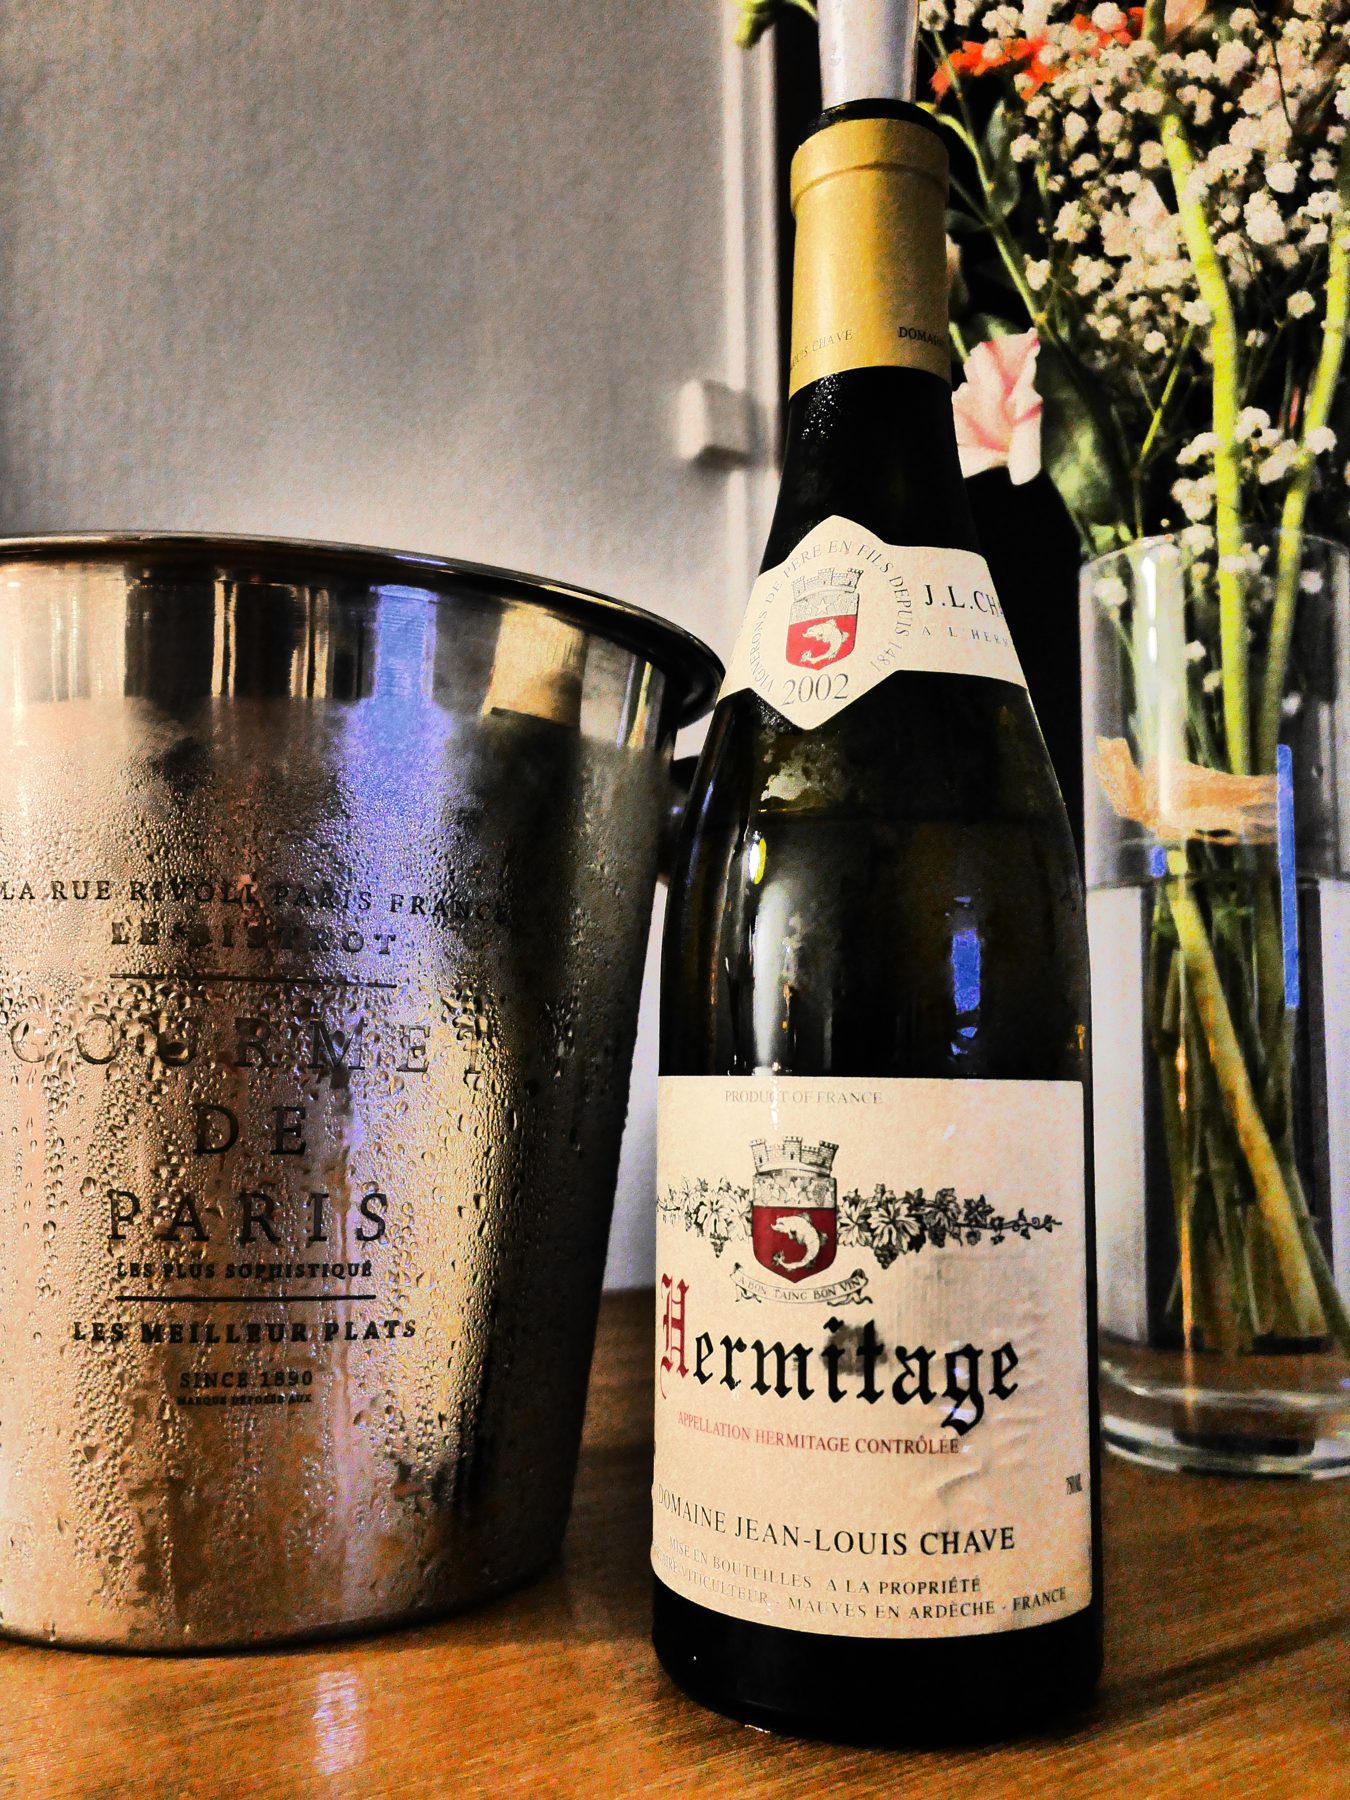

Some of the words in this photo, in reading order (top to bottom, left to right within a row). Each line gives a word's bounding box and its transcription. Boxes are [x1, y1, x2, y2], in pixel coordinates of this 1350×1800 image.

[812, 329, 853, 351] CHAVE
[828, 540, 852, 553] EN
[857, 544, 893, 573] FILS
[889, 576, 913, 637] DEPUIS
[870, 642, 901, 672] 1481
[782, 673, 849, 706] 2002
[1, 881, 35, 900] LA
[51, 881, 111, 899] RUE
[130, 880, 254, 903] RIVOLI
[274, 886, 372, 909] PARIS
[112, 922, 160, 944] LE
[725, 1090, 786, 1102] PRODUCT
[792, 1090, 812, 1103] OF
[817, 1091, 883, 1104] FRANCE
[193, 1104, 307, 1155] DE
[106, 1190, 388, 1242] PARIS
[116, 1263, 151, 1279] LES
[164, 1263, 215, 1279] PLUS
[748, 1281, 767, 1295] BON
[813, 1286, 837, 1299] BON
[840, 1278, 861, 1292] VIN
[73, 1322, 124, 1342] LES
[141, 1322, 307, 1344] MEILLEUR
[324, 1319, 416, 1341] PLATS
[660, 1276, 1020, 1436] Hermitage
[180, 1371, 248, 1388] SINCE
[260, 1370, 313, 1387] 1890
[678, 1411, 750, 1441] APPELLATION
[756, 1429, 849, 1452] HERMITAGE
[658, 1483, 726, 1533] DOMAINE
[735, 1516, 907, 1556] JEAN-LOUIS
[920, 1526, 1015, 1555] CHAVE
[669, 1536, 689, 1557] MISE
[694, 1549, 708, 1565] EN
[713, 1556, 812, 1588] BOUTEILLES
[846, 1579, 870, 1593] LA
[879, 1575, 981, 1595] PROPRIÉTÉ
[788, 1597, 866, 1618] MAUVES
[876, 1604, 899, 1618] EN
[908, 1600, 996, 1619] ARDÈCHE
[1012, 1587, 1066, 1611] FRANCE
